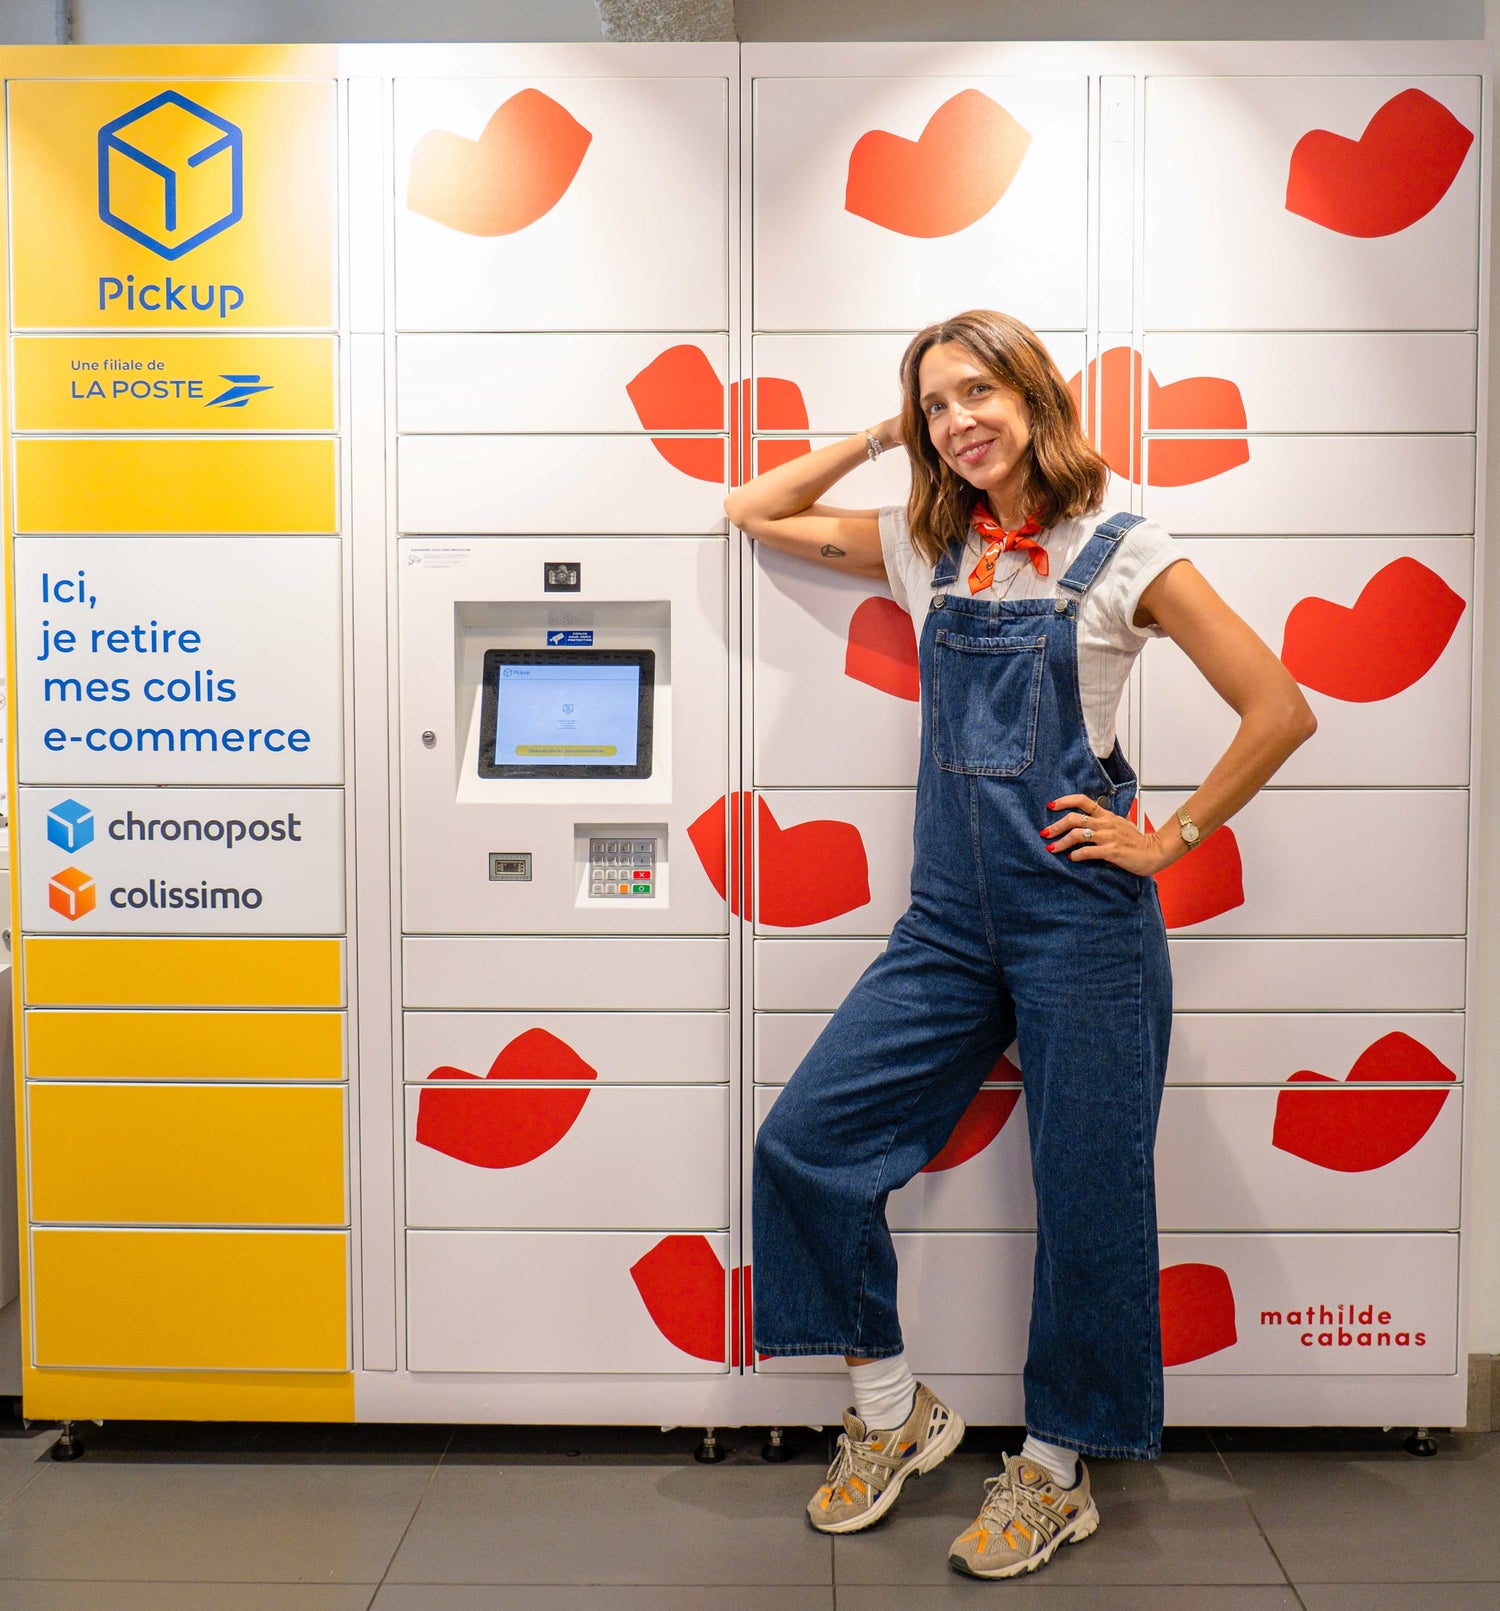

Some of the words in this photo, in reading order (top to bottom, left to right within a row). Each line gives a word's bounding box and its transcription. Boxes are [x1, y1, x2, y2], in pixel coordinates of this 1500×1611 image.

[99, 274, 244, 319] Pickup
[71, 360, 99, 371] Une
[103, 359, 143, 371] filiale
[147, 359, 165, 371] de
[71, 380, 106, 399] LA
[112, 380, 204, 399] POSTE
[42, 570, 97, 609] Ici,
[36, 619, 77, 662] je
[91, 620, 201, 654] retire
[44, 677, 131, 703] mes
[143, 669, 237, 703] colis
[43, 727, 311, 753] e-commerce
[107, 810, 302, 849] chronopost
[109, 878, 263, 910] colissimo
[1260, 1303, 1392, 1325] mathilde
[1300, 1326, 1427, 1347] cabanas
